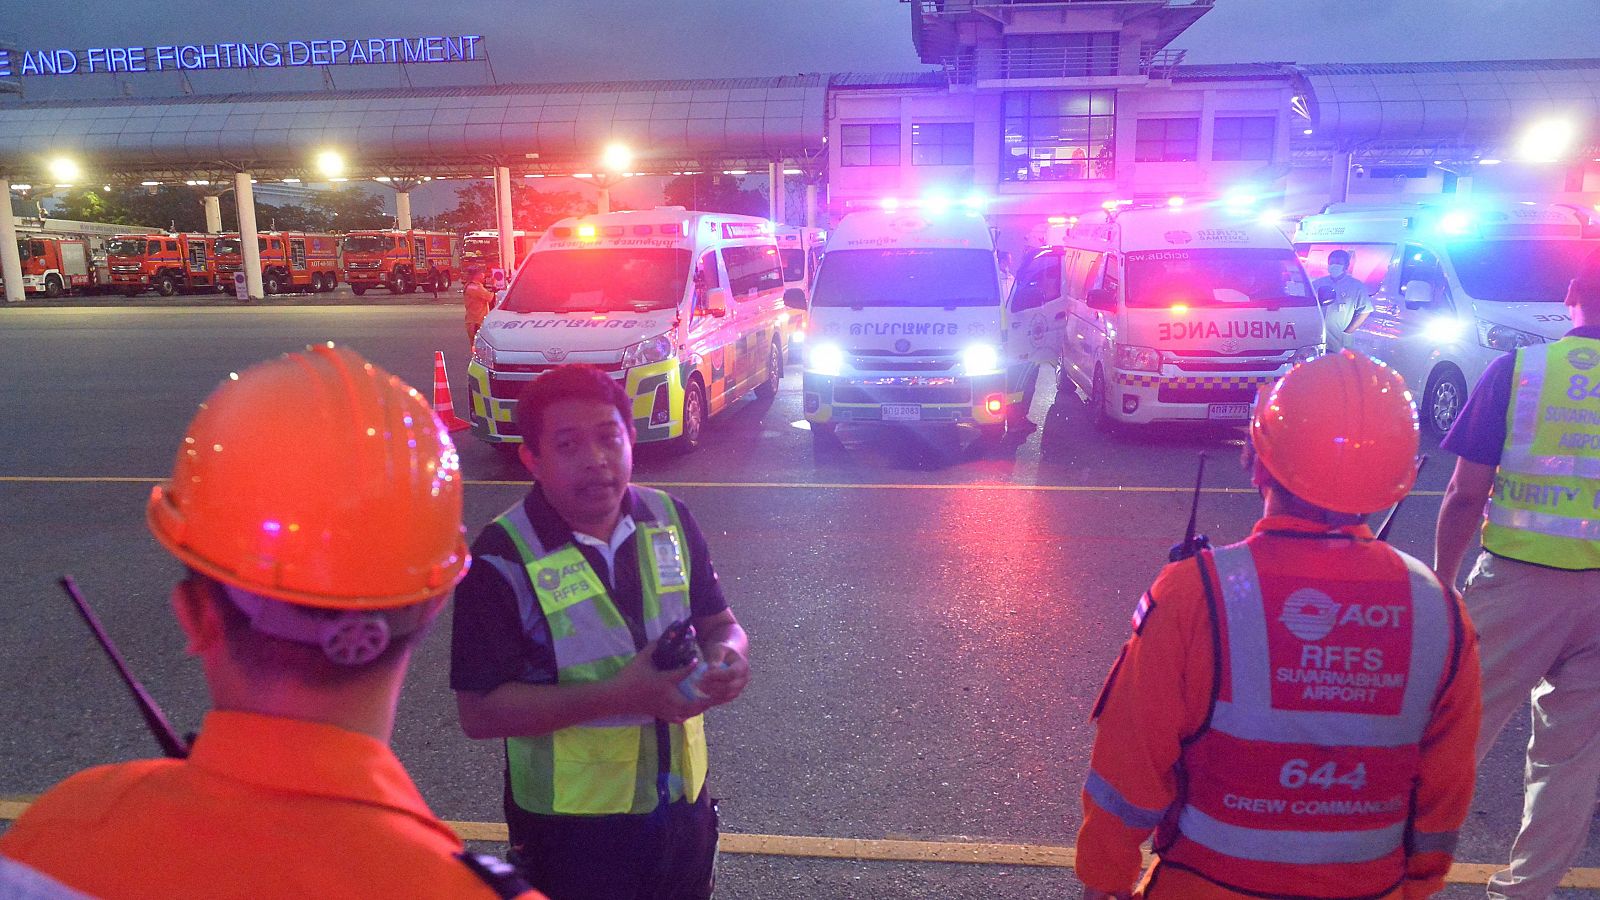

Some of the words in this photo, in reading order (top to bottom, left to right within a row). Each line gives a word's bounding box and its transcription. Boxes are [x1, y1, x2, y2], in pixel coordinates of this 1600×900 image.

[22, 49, 78, 75] AND
[87, 47, 147, 73] FIRE
[156, 43, 283, 71] FIGHTING
[289, 35, 480, 66] DEPARTMENT
[562, 560, 587, 578] AOT
[553, 580, 590, 603] RFFS
[1340, 604, 1407, 628] AOT
[1301, 645, 1384, 672] RFFS
[1303, 686, 1377, 703] AIRPORT
[1279, 758, 1368, 791] 644
[1222, 793, 1288, 815] CREW
